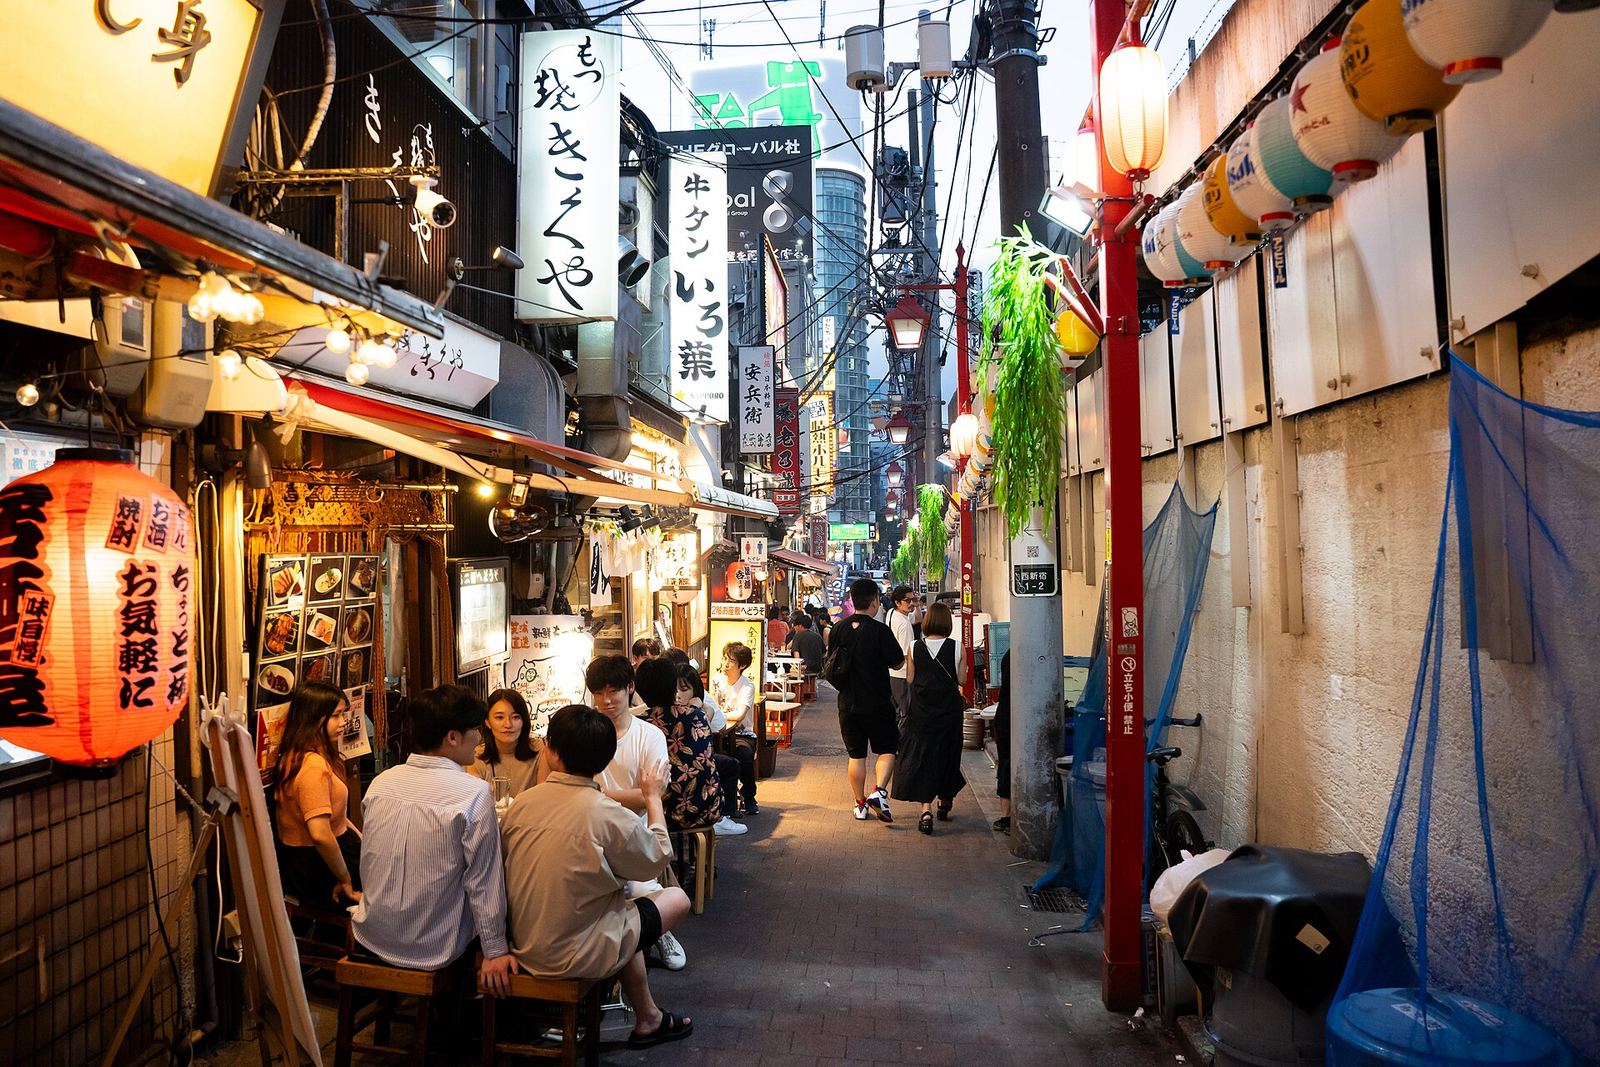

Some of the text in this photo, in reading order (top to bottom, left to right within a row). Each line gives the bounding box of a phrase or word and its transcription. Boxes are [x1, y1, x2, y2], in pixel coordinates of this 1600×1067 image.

[683, 172, 711, 259] 牛タン
[674, 270, 723, 381] いろ葉
[744, 363, 762, 425] 安兵衛
[109, 496, 141, 548] 焼酎
[147, 499, 170, 549] お酒
[1022, 571, 1047, 581] 西新宿
[119, 563, 158, 710] お気軽に
[1123, 672, 1134, 712] 立ち小便
[1123, 715, 1134, 735] 禁止
